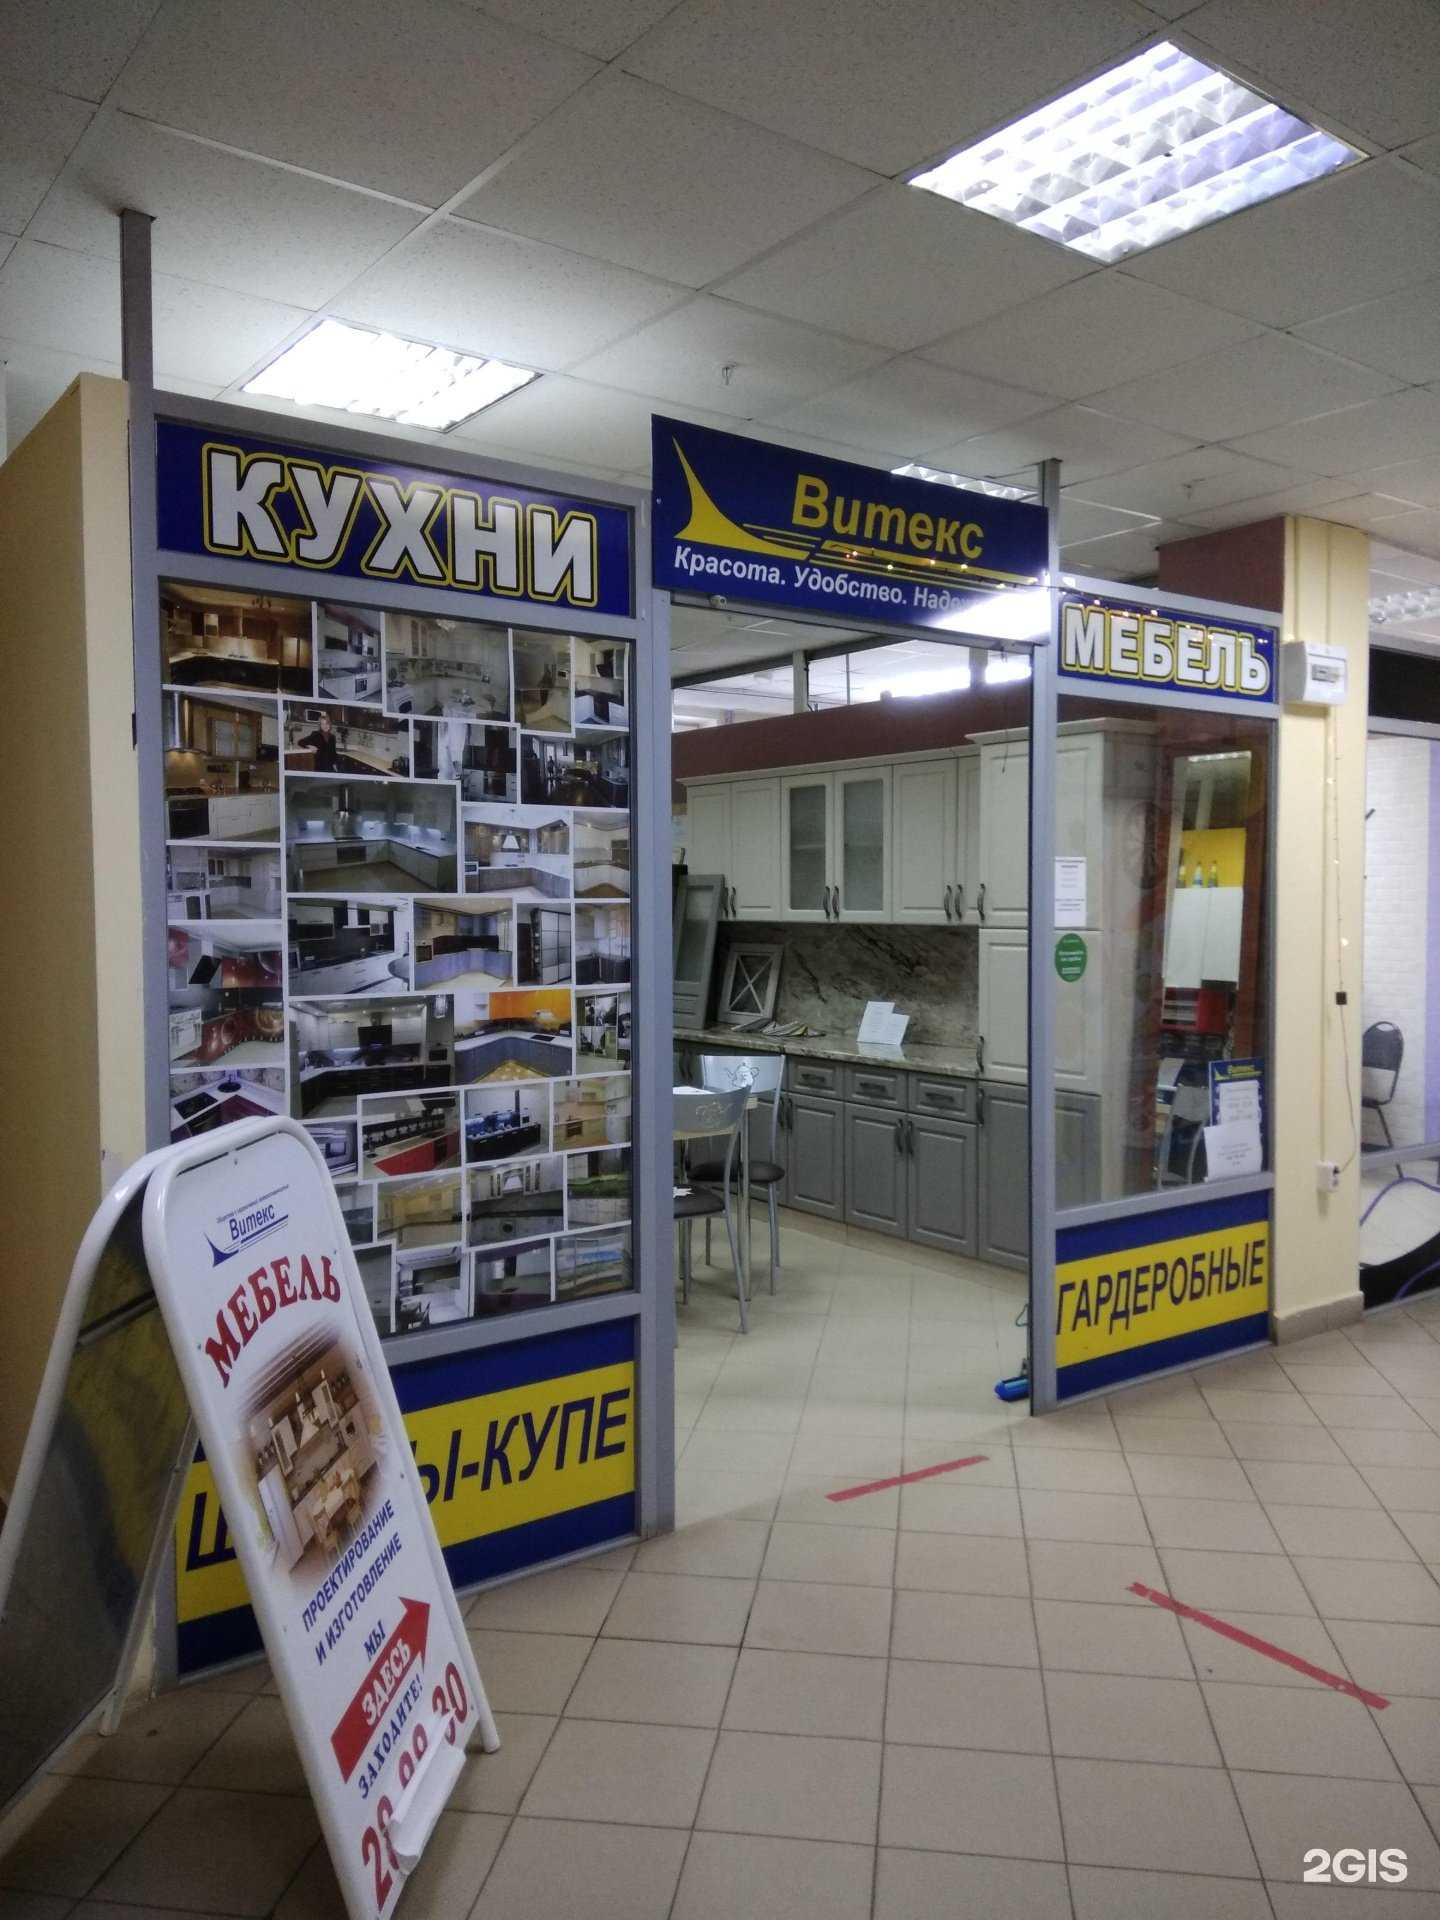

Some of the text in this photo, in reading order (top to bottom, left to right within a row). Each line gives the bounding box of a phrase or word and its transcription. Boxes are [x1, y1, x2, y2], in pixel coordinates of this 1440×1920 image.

[204, 445, 597, 605] КУХНИ
[791, 473, 985, 560] Витекс
[674, 545, 787, 585] Красота.
[794, 565, 908, 605] Удобство.
[1063, 604, 1268, 692] МЕБЕЛЬ
[229, 1204, 275, 1241] Витекс
[205, 1254, 341, 1390] МЕБЕЛЬ
[1056, 1240, 1265, 1335] ГАРДЕРОБНЫЕ
[302, 1500, 394, 1632] ПРОЕКТИРОВАНИЕ
[315, 1532, 402, 1666] И ИЗГОТОВЛЕНИЕ
[361, 1638, 411, 1726] ЗДЕСЬ
[364, 1620, 386, 1661] МЫ
[358, 1673, 424, 1799] ЗАХОДИТЕ!
